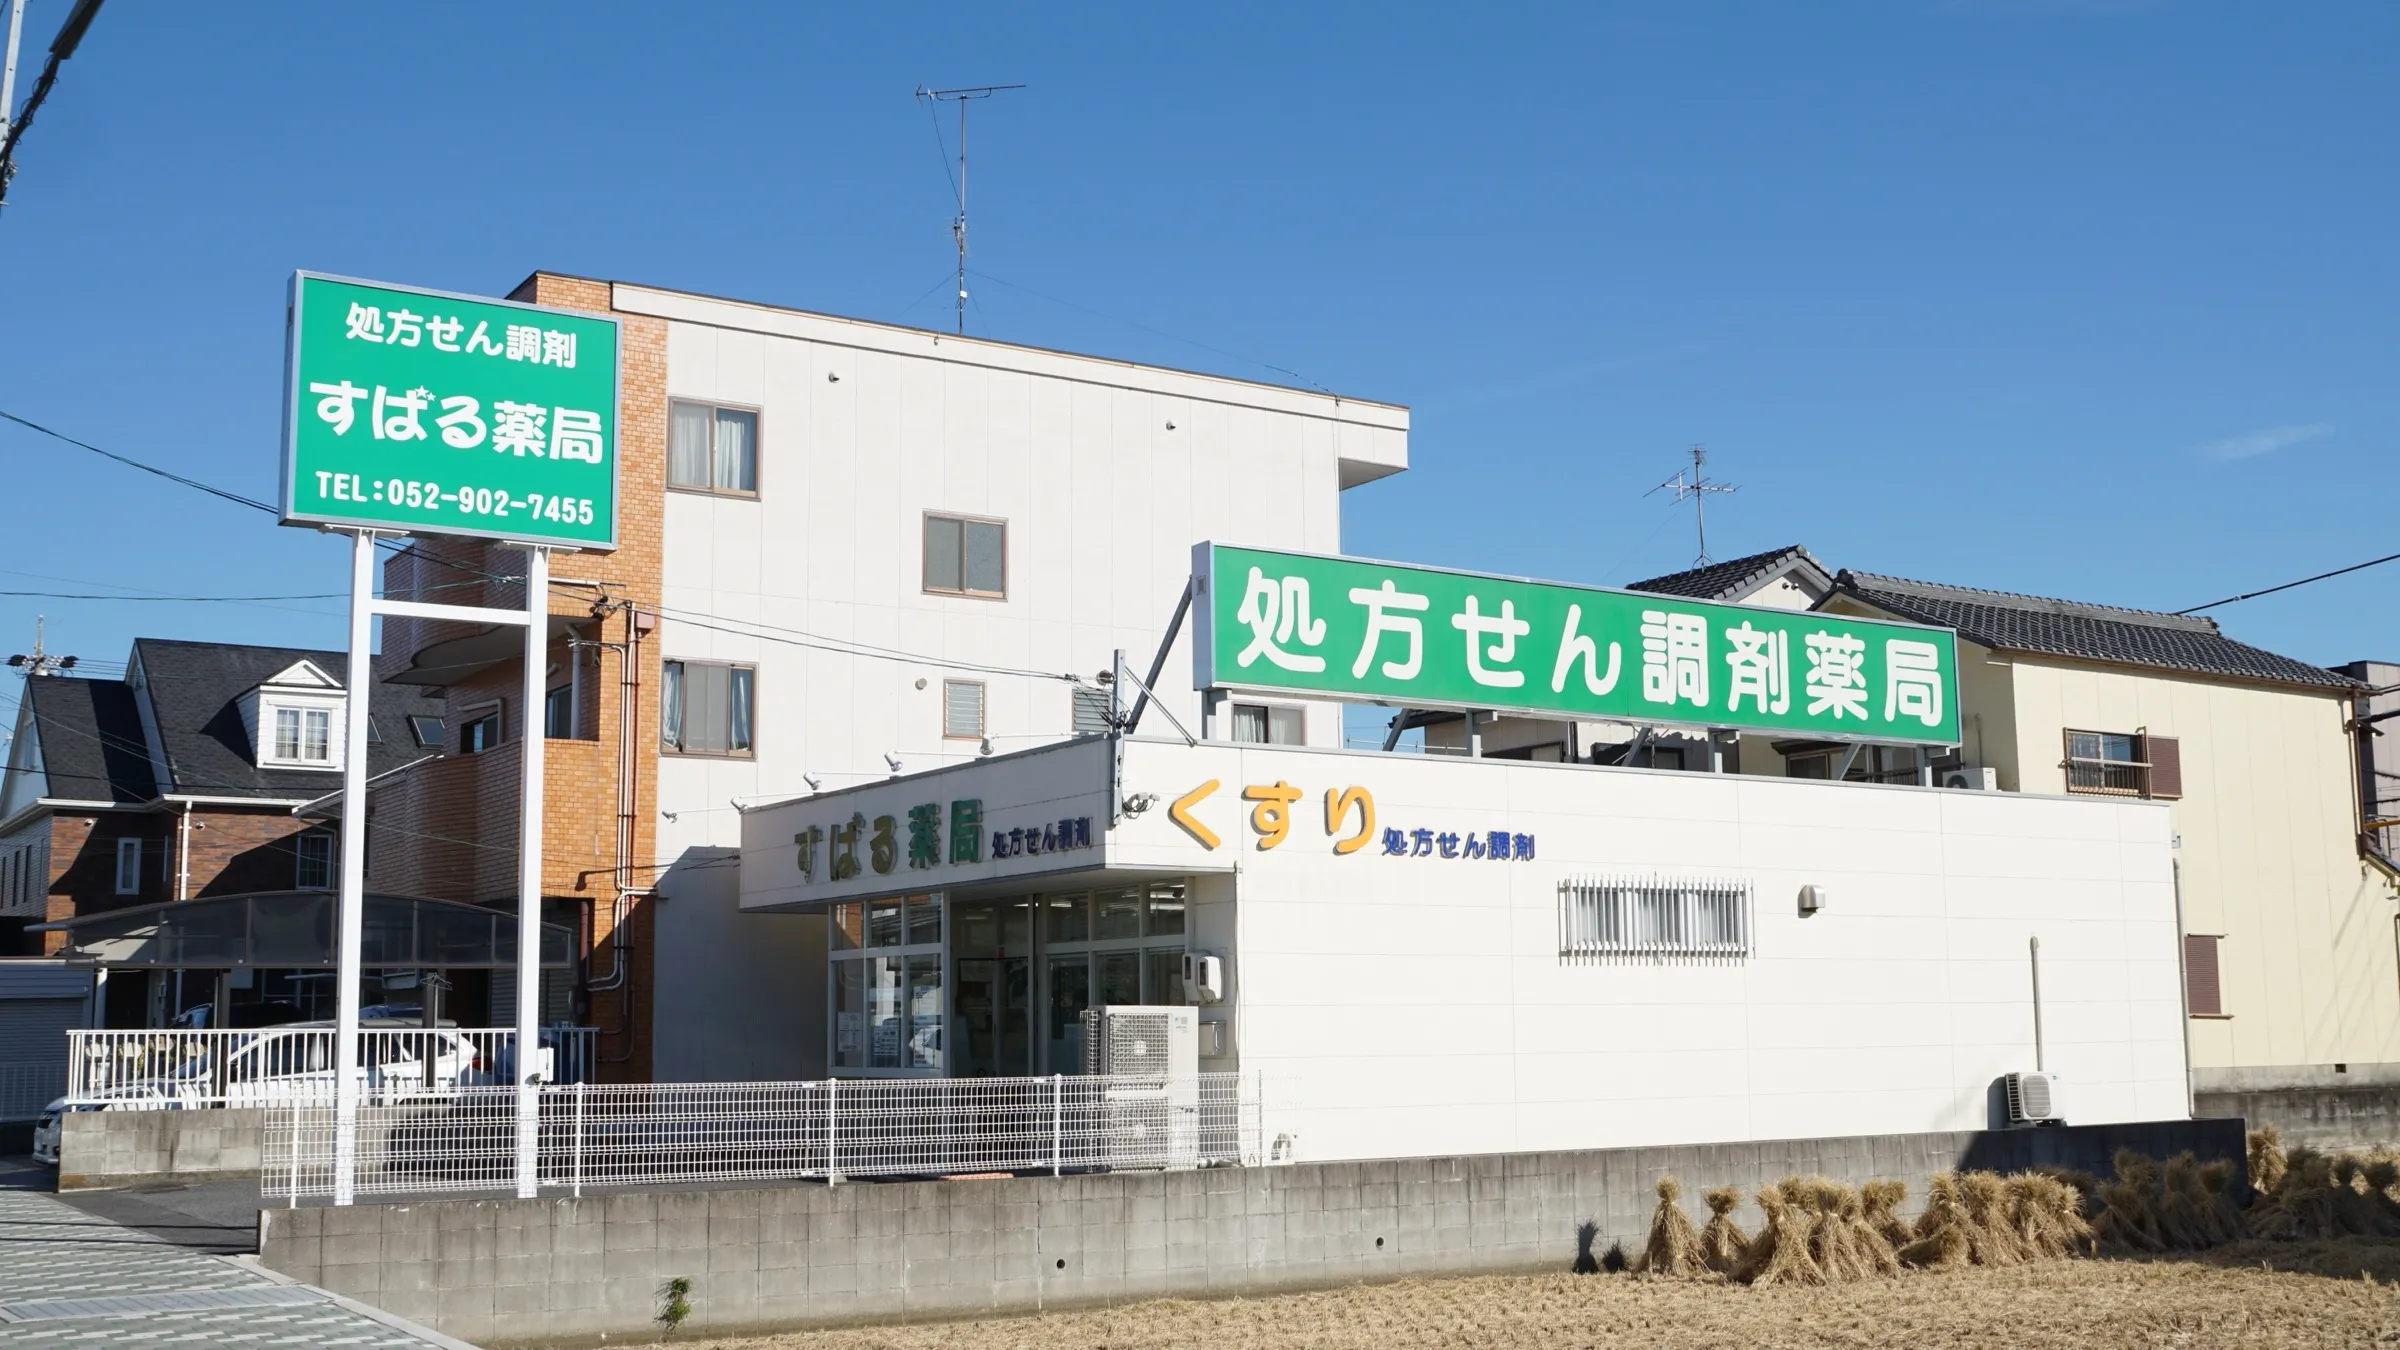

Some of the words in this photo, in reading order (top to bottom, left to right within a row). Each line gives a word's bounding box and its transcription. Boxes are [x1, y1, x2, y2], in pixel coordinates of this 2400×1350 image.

[345, 302, 577, 369] 処方せん調剤
[309, 380, 604, 464] すばる薬局
[1236, 566, 1943, 728] 処方せん調剤薬局
[794, 798, 984, 884] すばる薬局
[991, 815, 1094, 860] 処方せん調剤
[1169, 778, 1376, 855] くすり
[1382, 827, 1536, 861] 処方せん調剤
